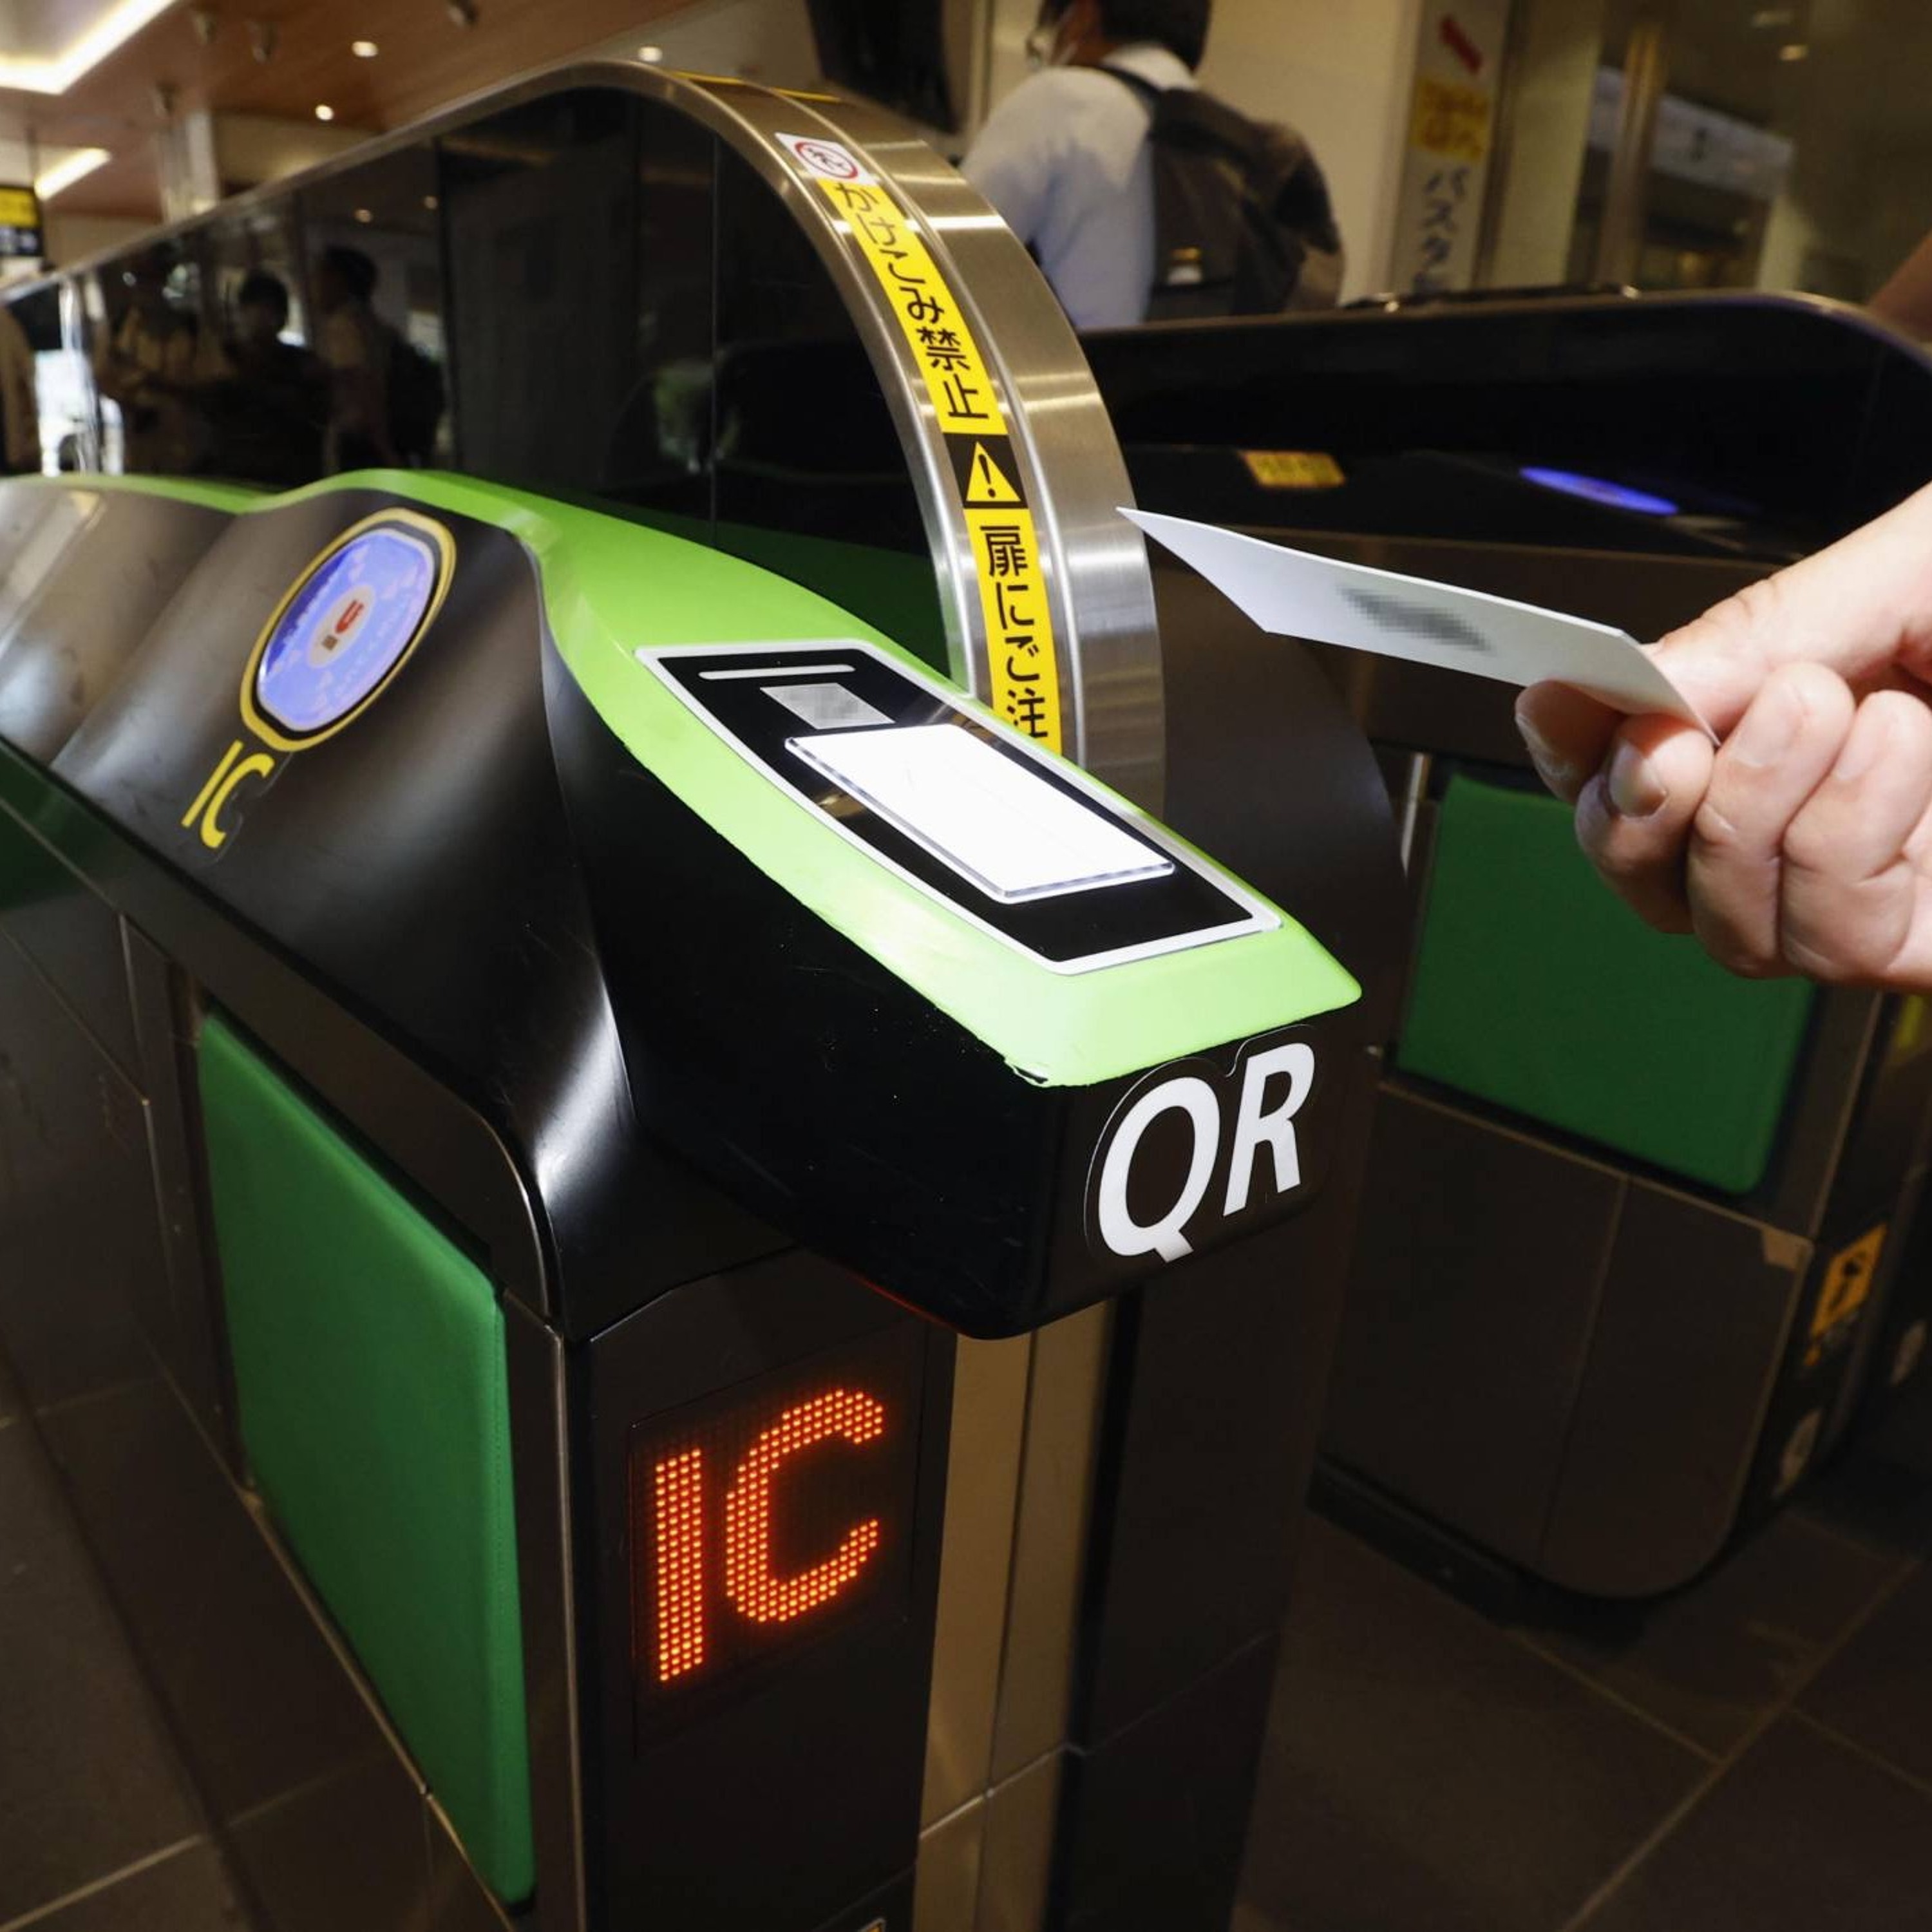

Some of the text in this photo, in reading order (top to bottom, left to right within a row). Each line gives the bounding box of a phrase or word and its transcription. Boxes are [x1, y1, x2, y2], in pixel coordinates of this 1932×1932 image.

[835, 183, 989, 419] かけこみ禁止
[181, 739, 275, 849] IC
[1098, 1043, 1315, 1264] QR
[656, 1388, 884, 1682] IC
